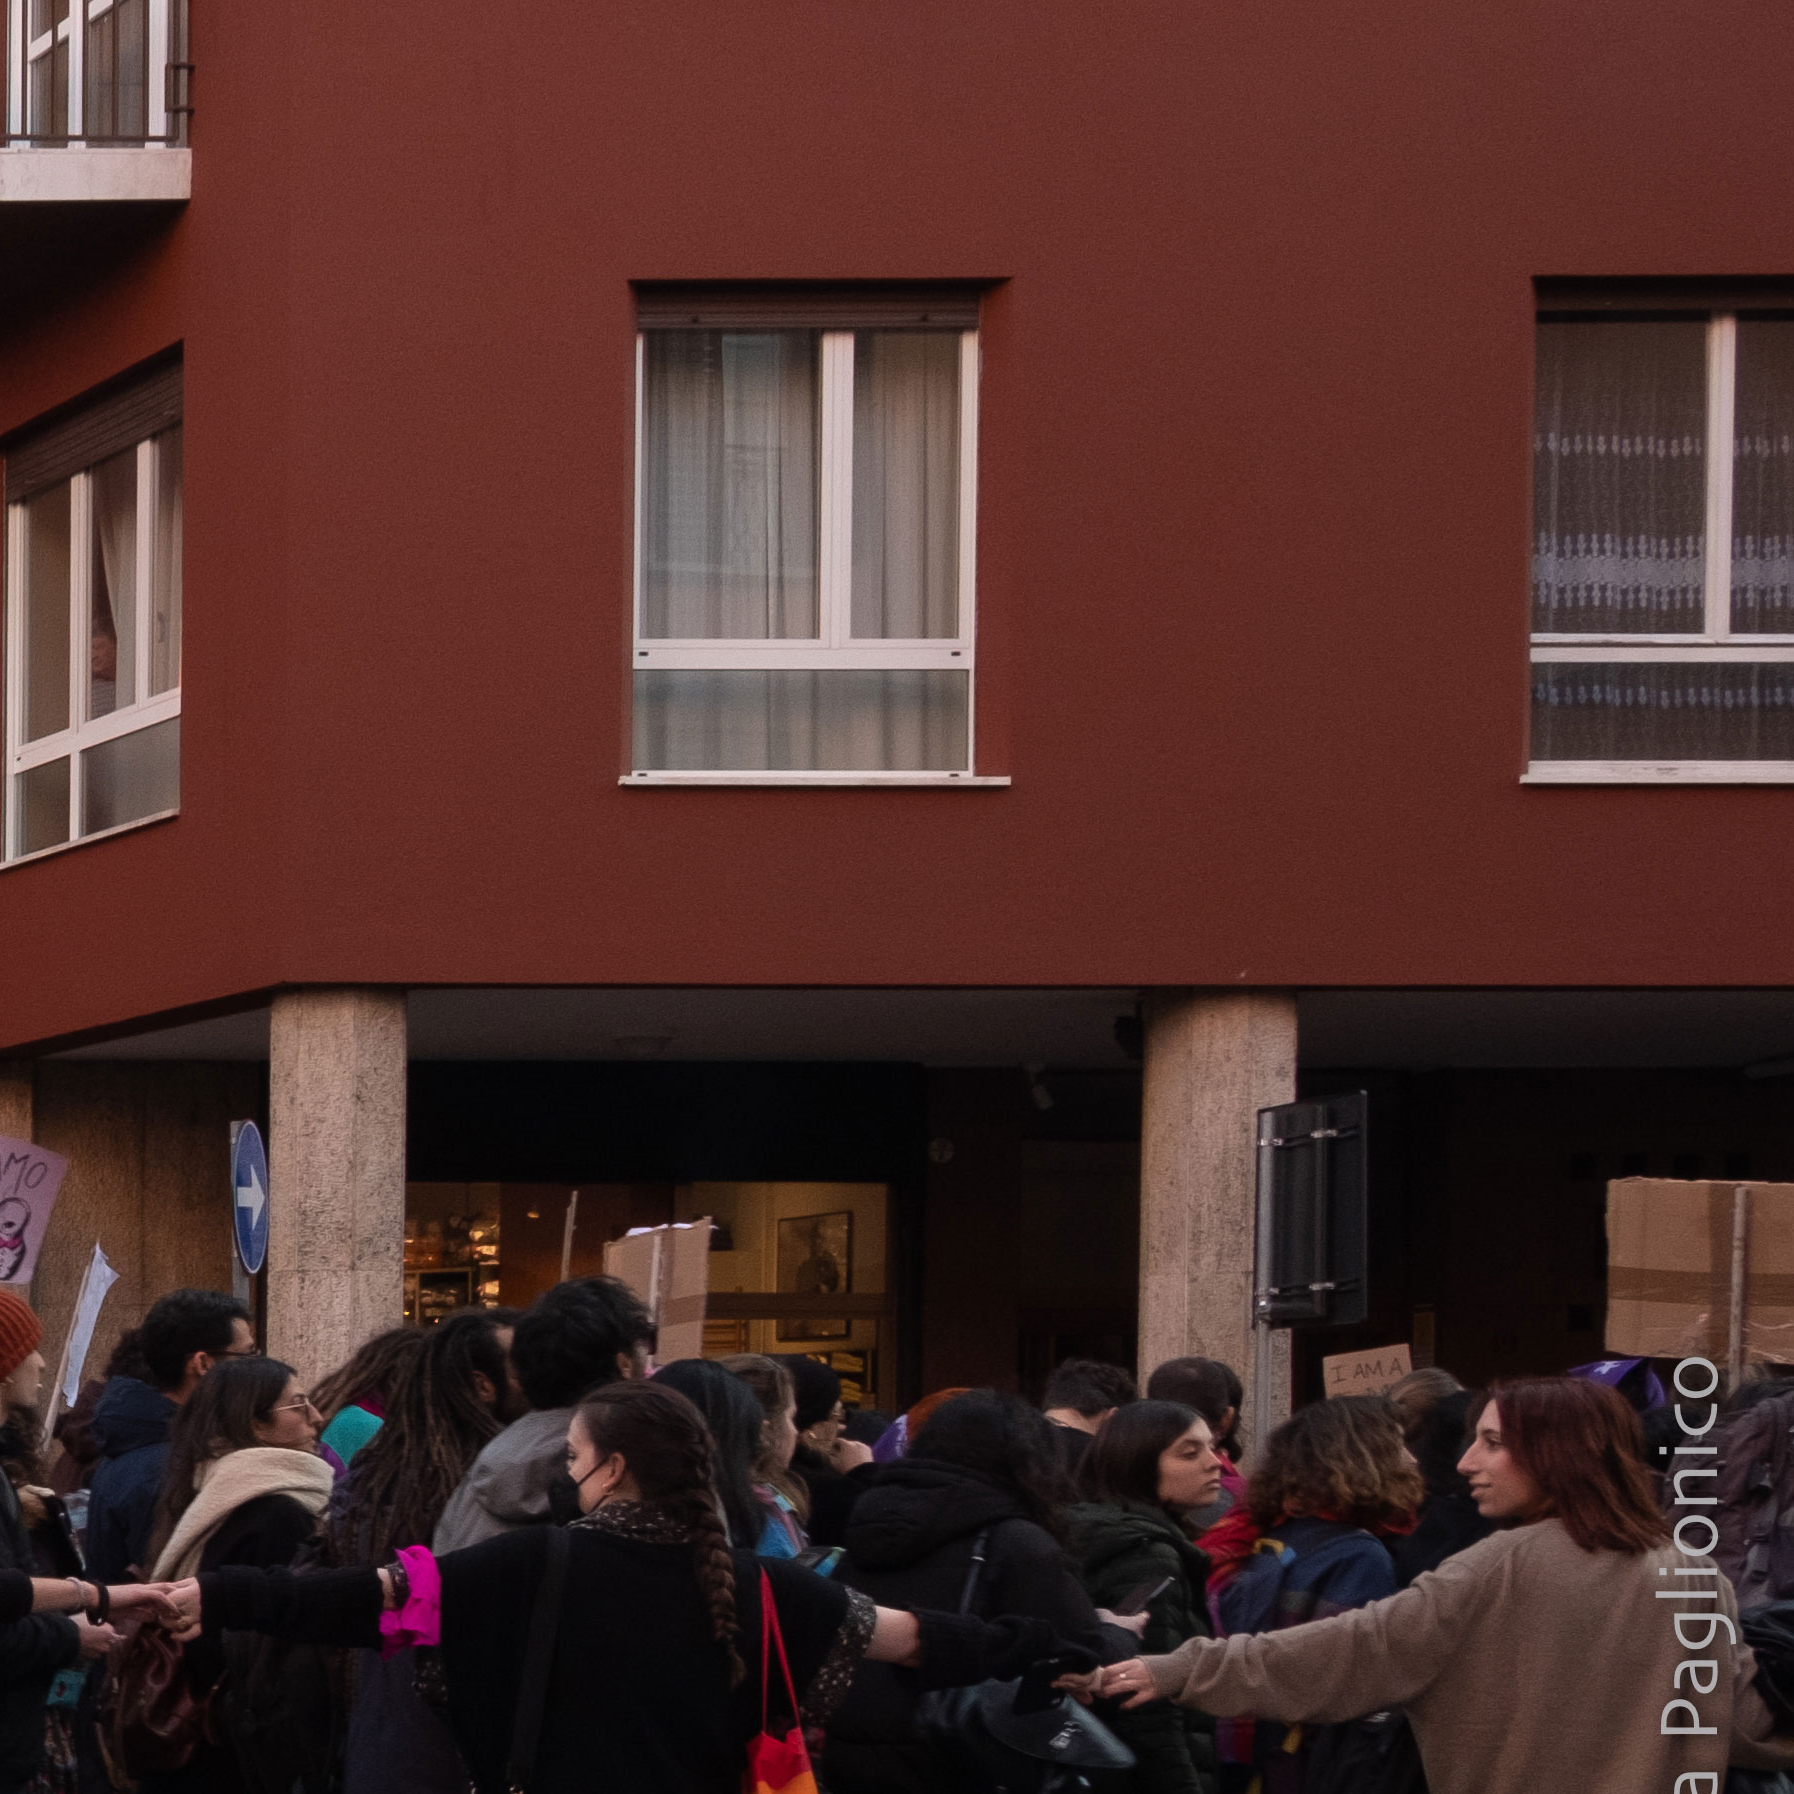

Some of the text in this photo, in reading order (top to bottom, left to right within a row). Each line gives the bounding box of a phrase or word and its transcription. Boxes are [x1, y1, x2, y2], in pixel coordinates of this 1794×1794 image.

[1330, 1357, 1404, 1384] I AM A
